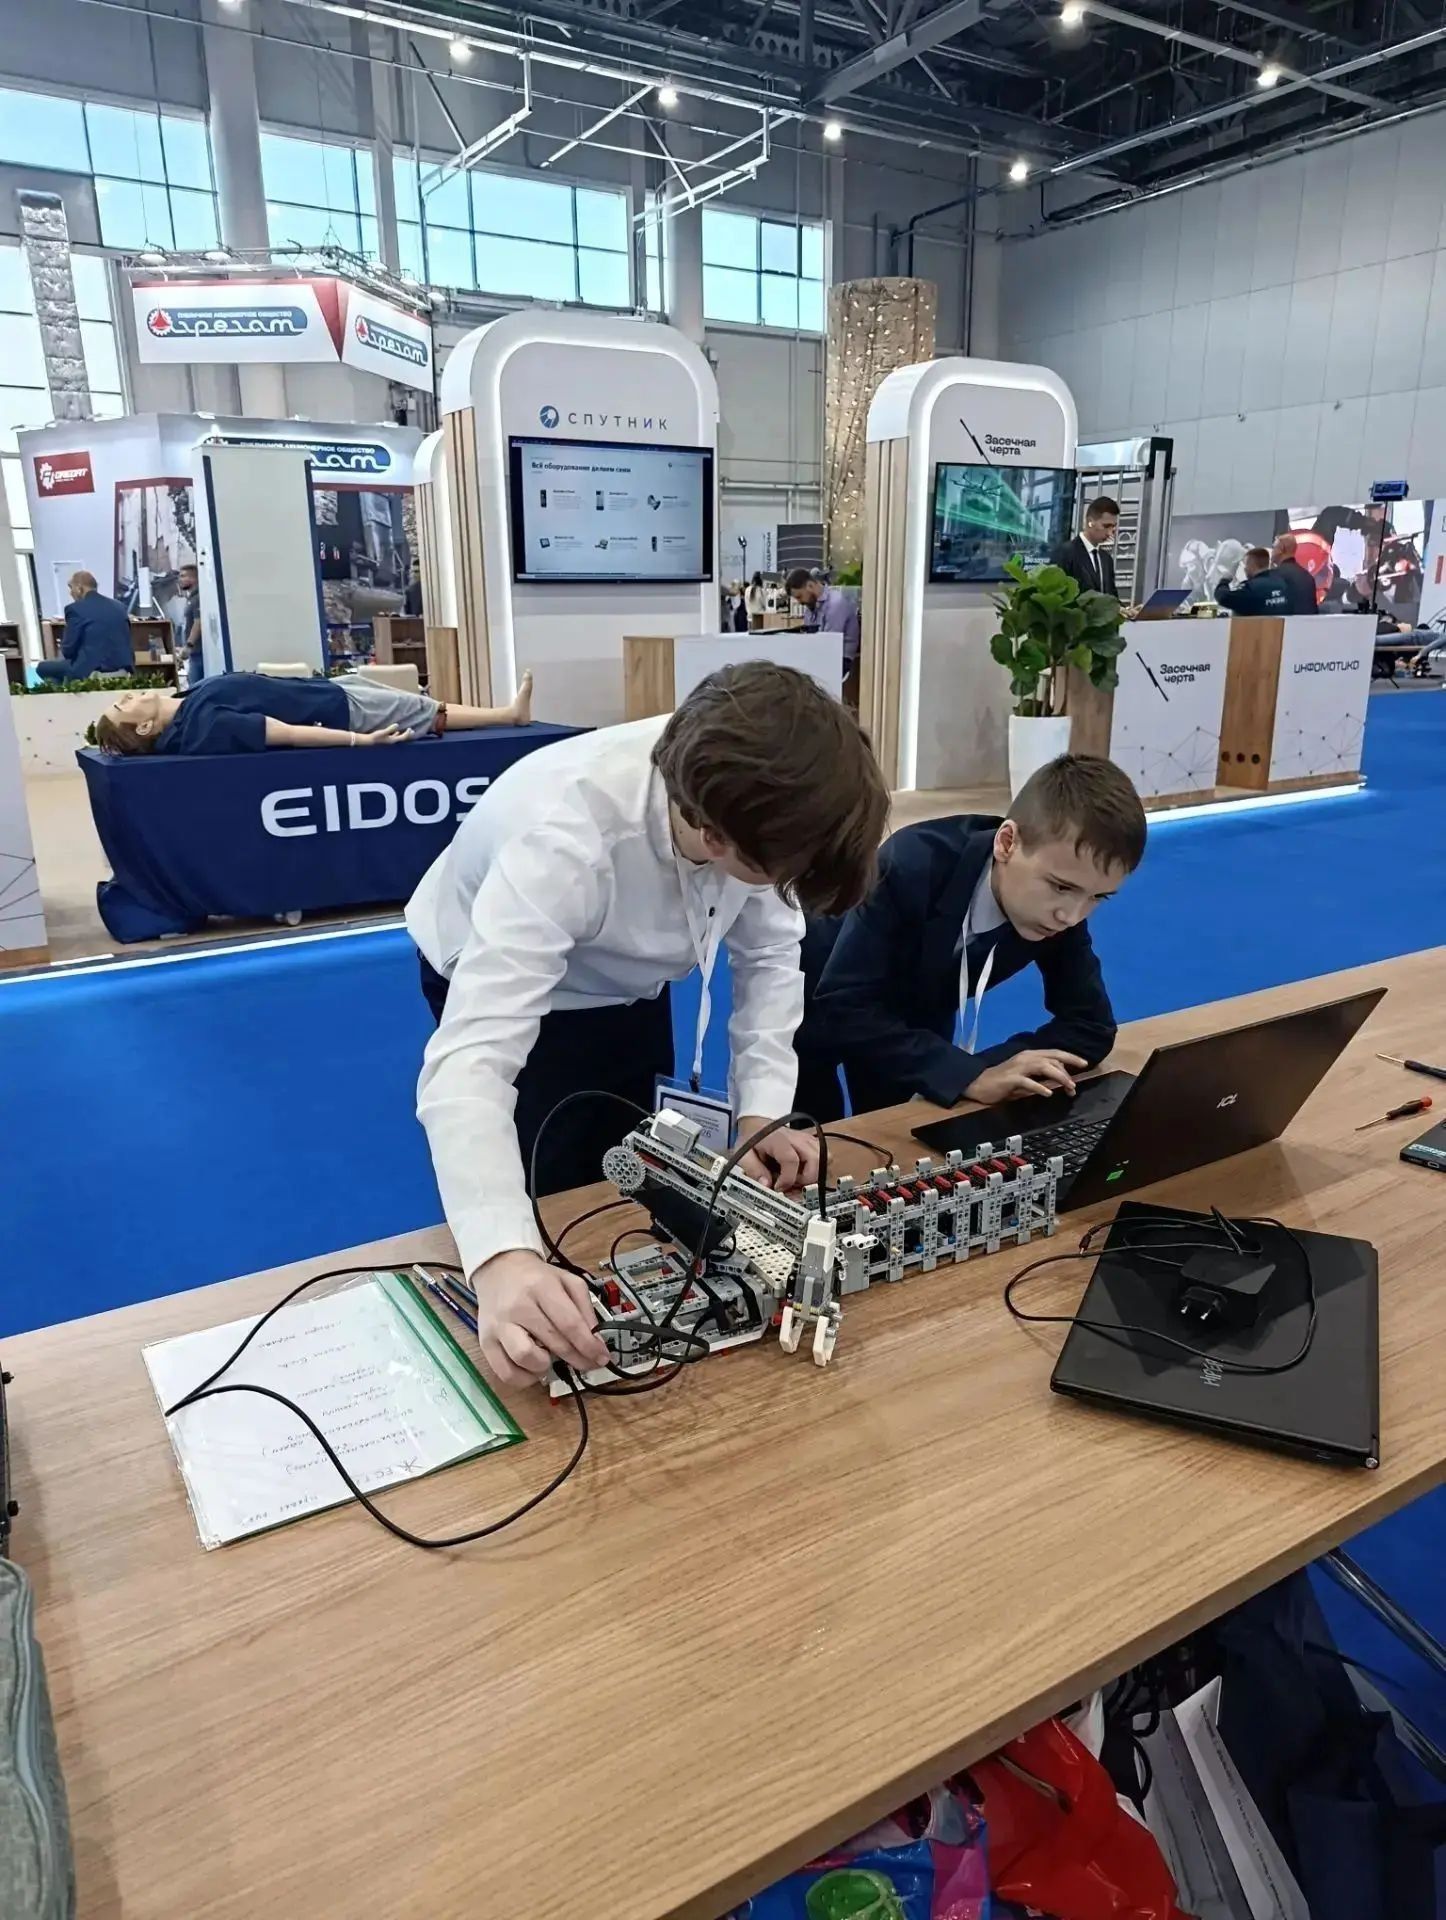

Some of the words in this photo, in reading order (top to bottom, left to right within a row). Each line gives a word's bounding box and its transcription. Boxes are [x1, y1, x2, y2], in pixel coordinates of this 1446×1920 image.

[568, 412, 668, 430] СПУТНИК
[985, 434, 1036, 447] Засечная
[989, 446, 1021, 456] черта
[1160, 664, 1211, 674] Засечная
[1164, 674, 1195, 685] черта
[260, 776, 490, 838] EIDOS
